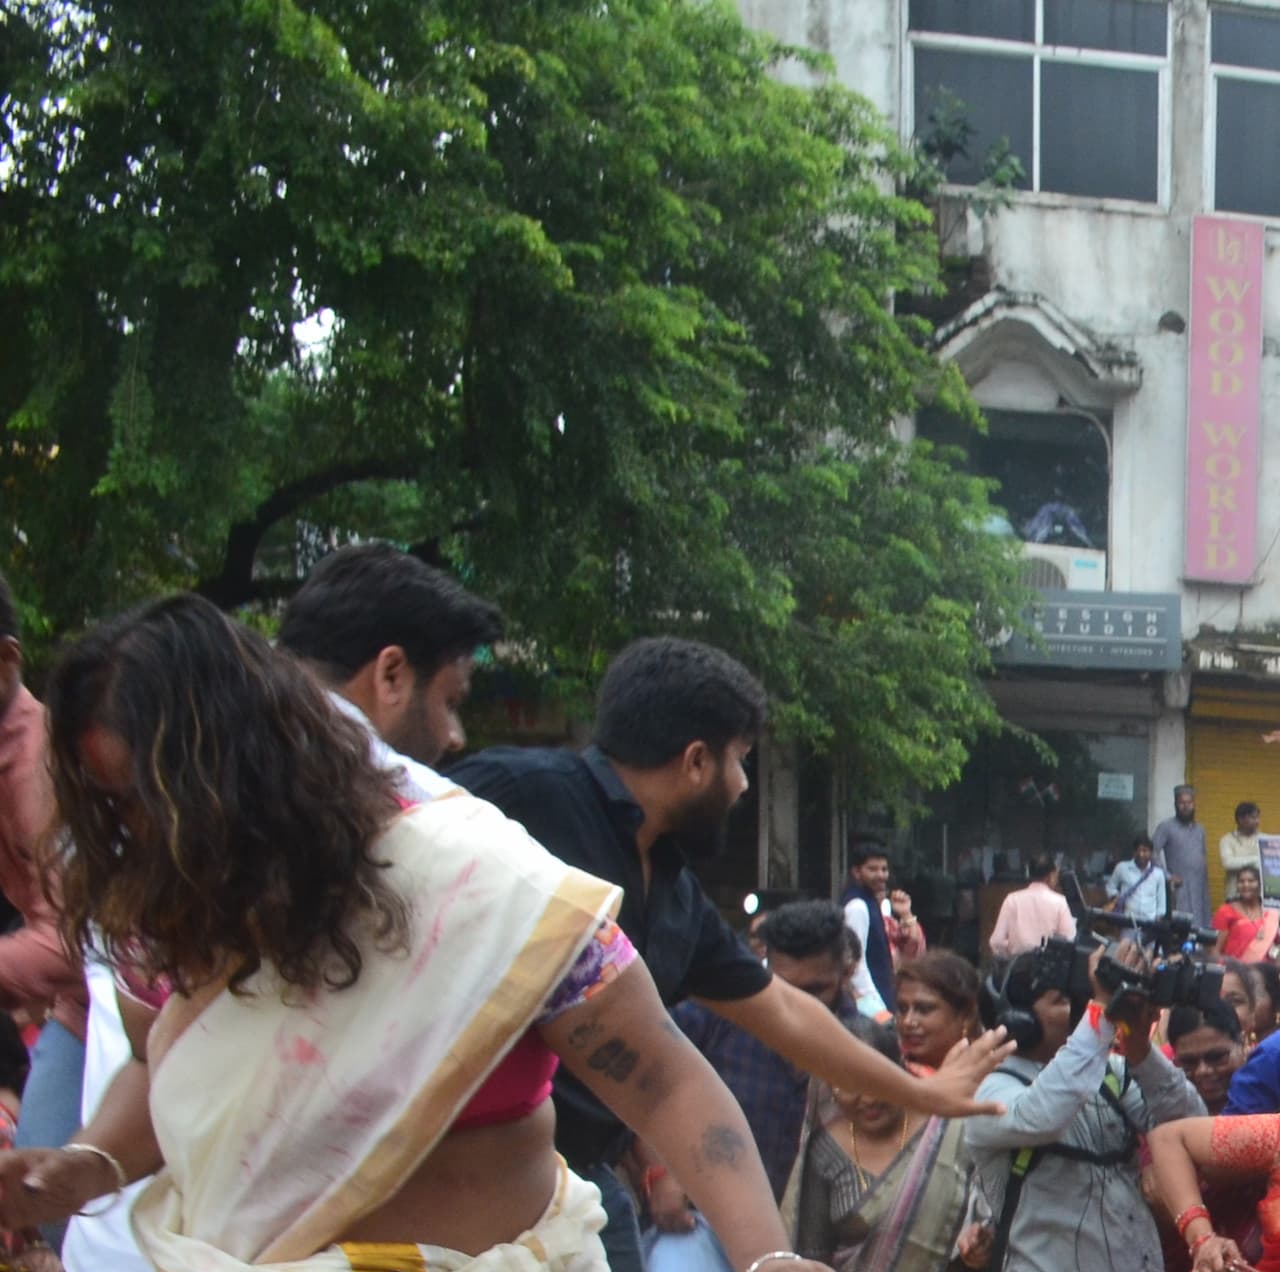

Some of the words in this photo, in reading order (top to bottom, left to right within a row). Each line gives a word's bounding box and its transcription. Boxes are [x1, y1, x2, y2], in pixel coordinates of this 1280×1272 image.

[1206, 276, 1250, 396] WOOD
[1202, 420, 1247, 571] WORLD
[1034, 621, 1158, 638] STUDIO
